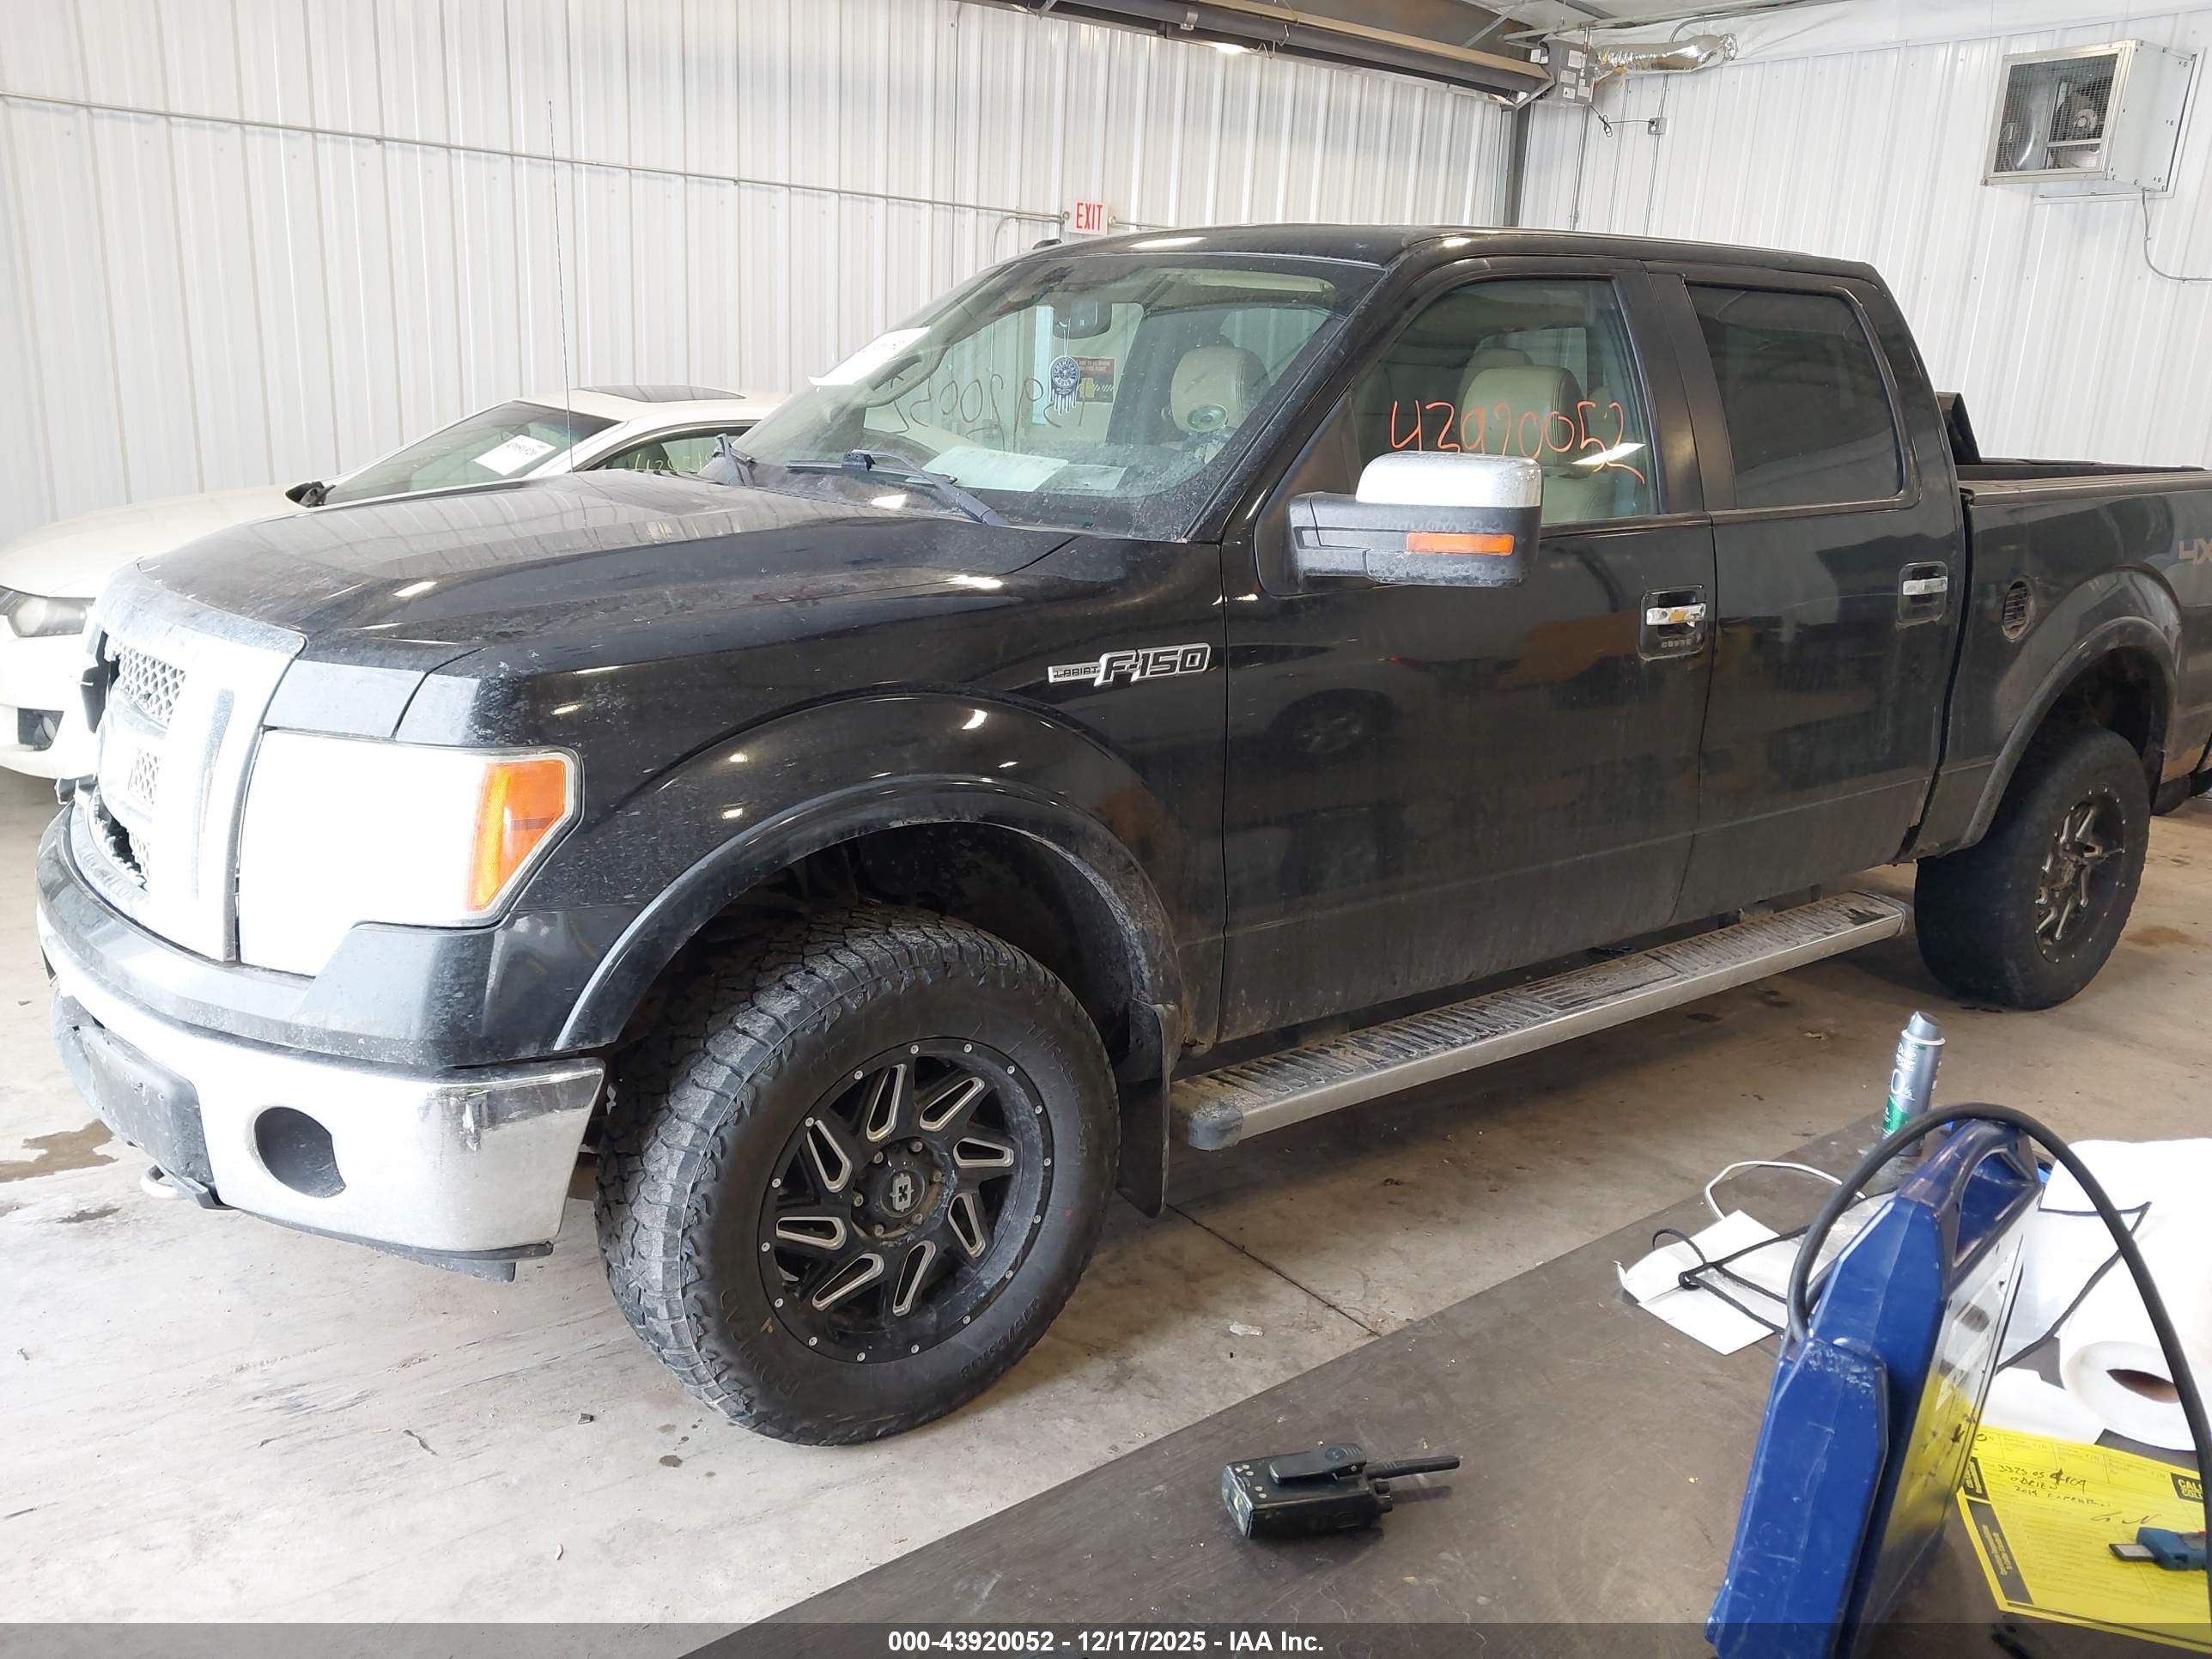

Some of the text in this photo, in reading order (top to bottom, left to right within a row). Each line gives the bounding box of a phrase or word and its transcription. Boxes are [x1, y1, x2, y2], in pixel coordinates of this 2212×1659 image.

[1075, 202, 1103, 231] EXIT
[1054, 642, 1212, 687] LARIAT F-150
